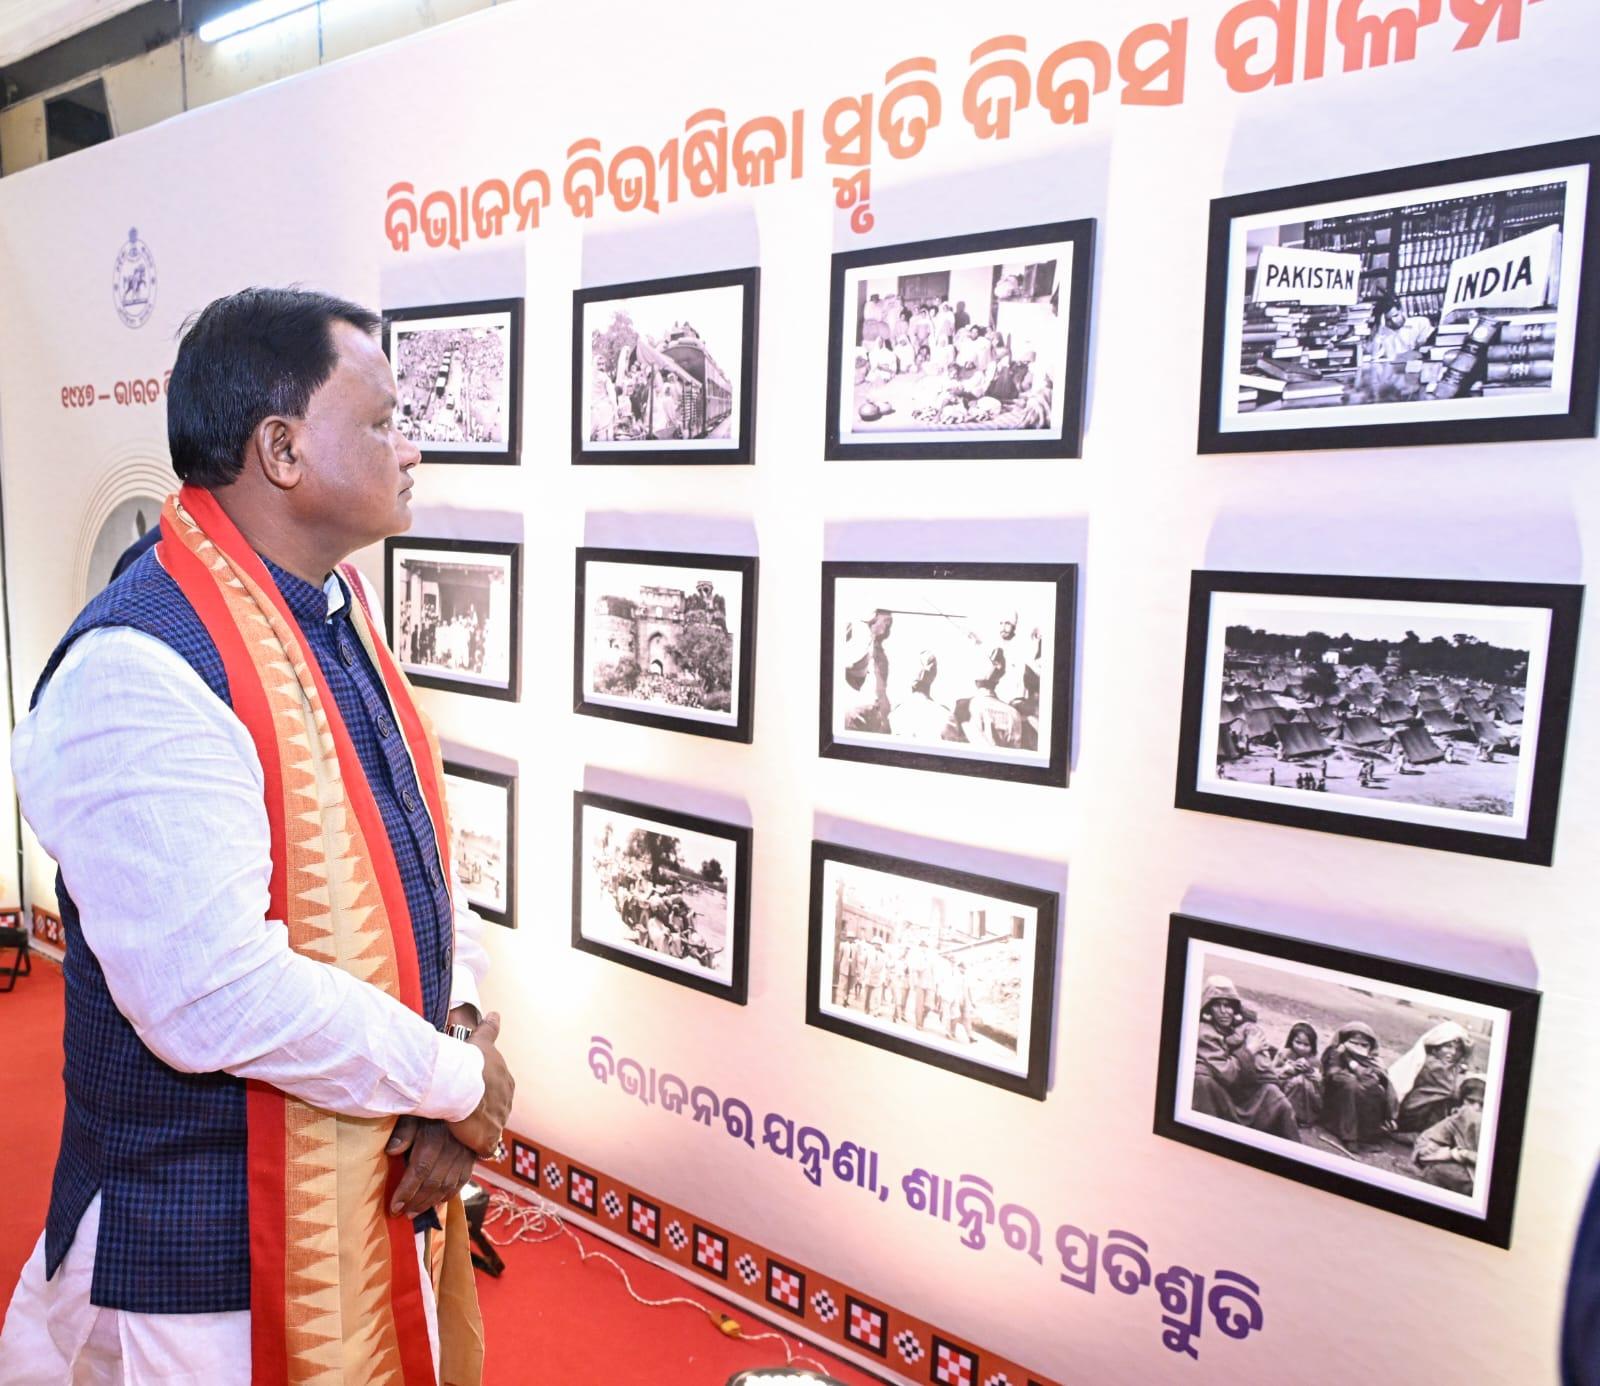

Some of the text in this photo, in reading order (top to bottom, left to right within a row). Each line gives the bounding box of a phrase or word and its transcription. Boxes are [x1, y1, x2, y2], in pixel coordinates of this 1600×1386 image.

[385, 170, 550, 251] ବିଭାଜନ
[564, 109, 803, 217] ବିଭୀଷିକା
[824, 58, 941, 233] ସ୍ମୃତି
[964, 18, 1187, 139] ଦିବସ
[1266, 263, 1356, 292] PAKISTAN
[1453, 255, 1533, 304] INDIA
[61, 384, 95, 408] ୧୯୪୭
[114, 378, 160, 405] ଭାରତ
[589, 1036, 756, 1149] ବିଭାଜନର
[901, 1167, 1042, 1265] ଶାନ୍ତିର
[1056, 1224, 1265, 1361] ପ୍ରତିଶ୍ରୁତି
